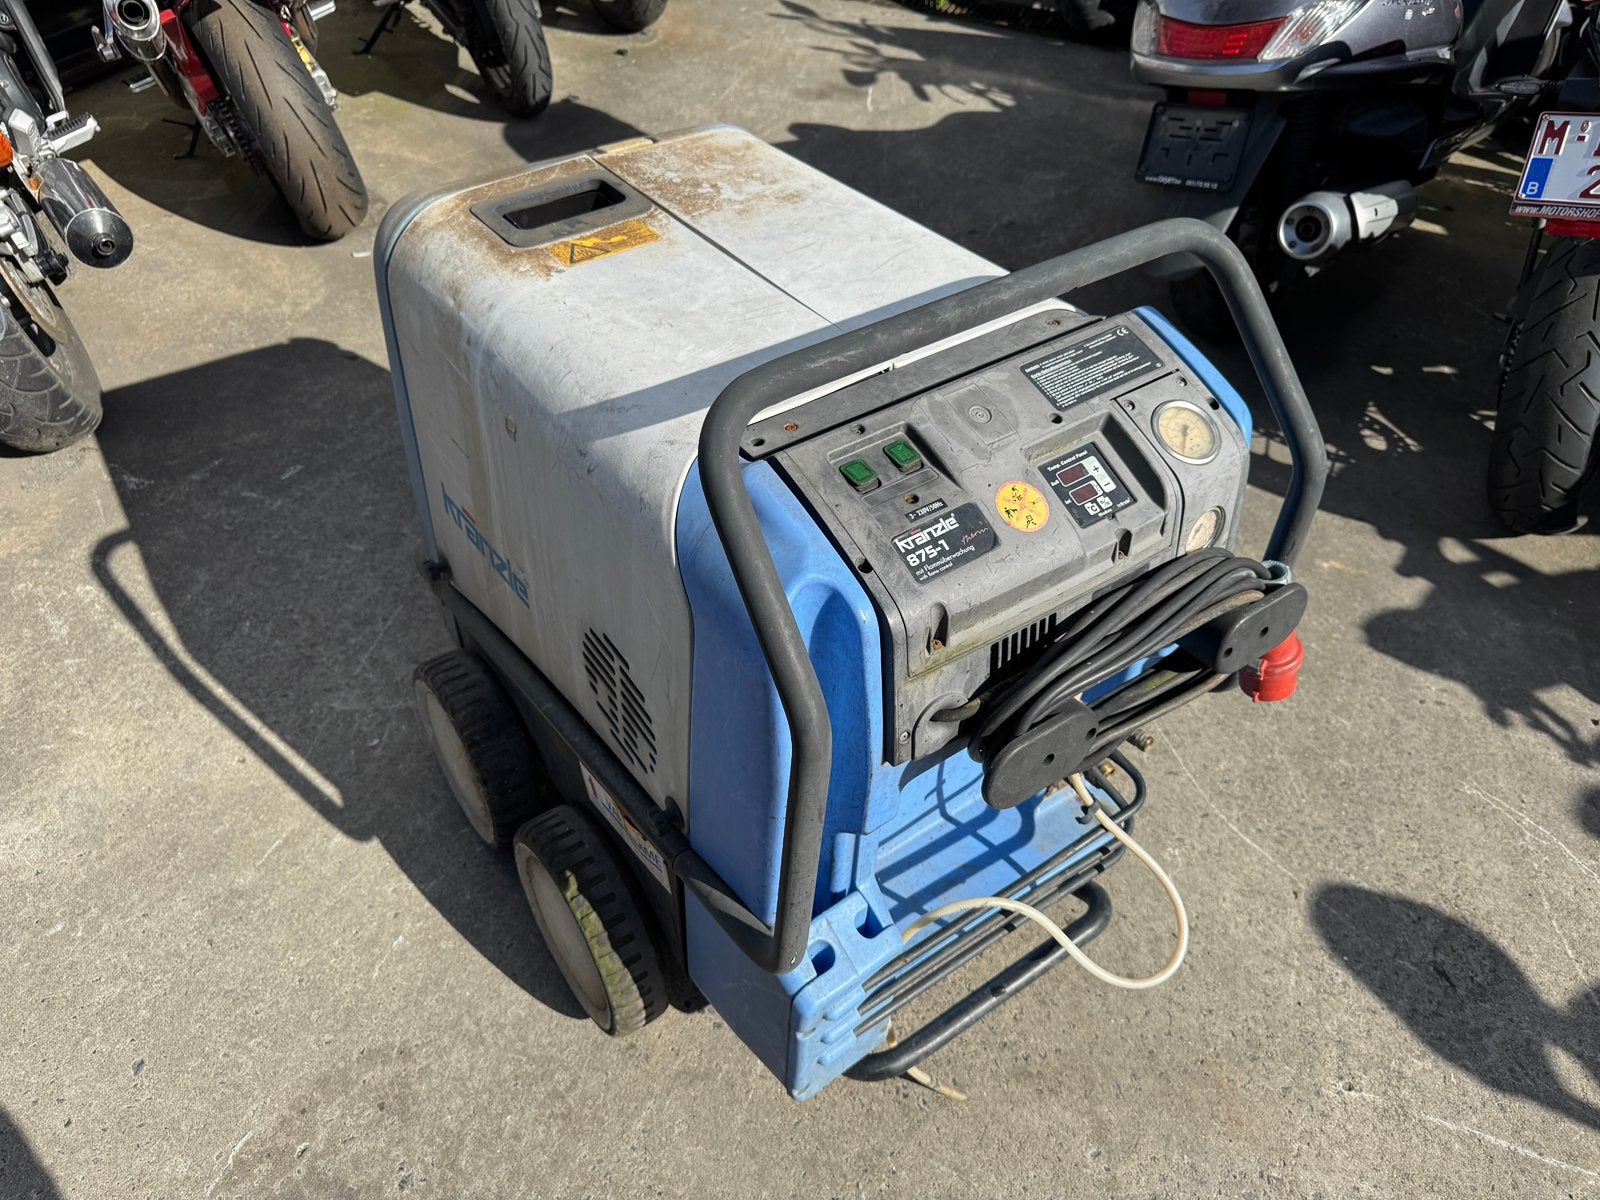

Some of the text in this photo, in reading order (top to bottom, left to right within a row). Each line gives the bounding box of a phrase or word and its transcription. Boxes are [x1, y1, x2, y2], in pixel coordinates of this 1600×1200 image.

[1538, 120, 1600, 157] M-
[1526, 182, 1539, 195] B
[1060, 455, 1076, 466] Control
[1076, 449, 1088, 459] Panel
[906, 539, 950, 567] 875-1
[915, 568, 925, 576] mit
